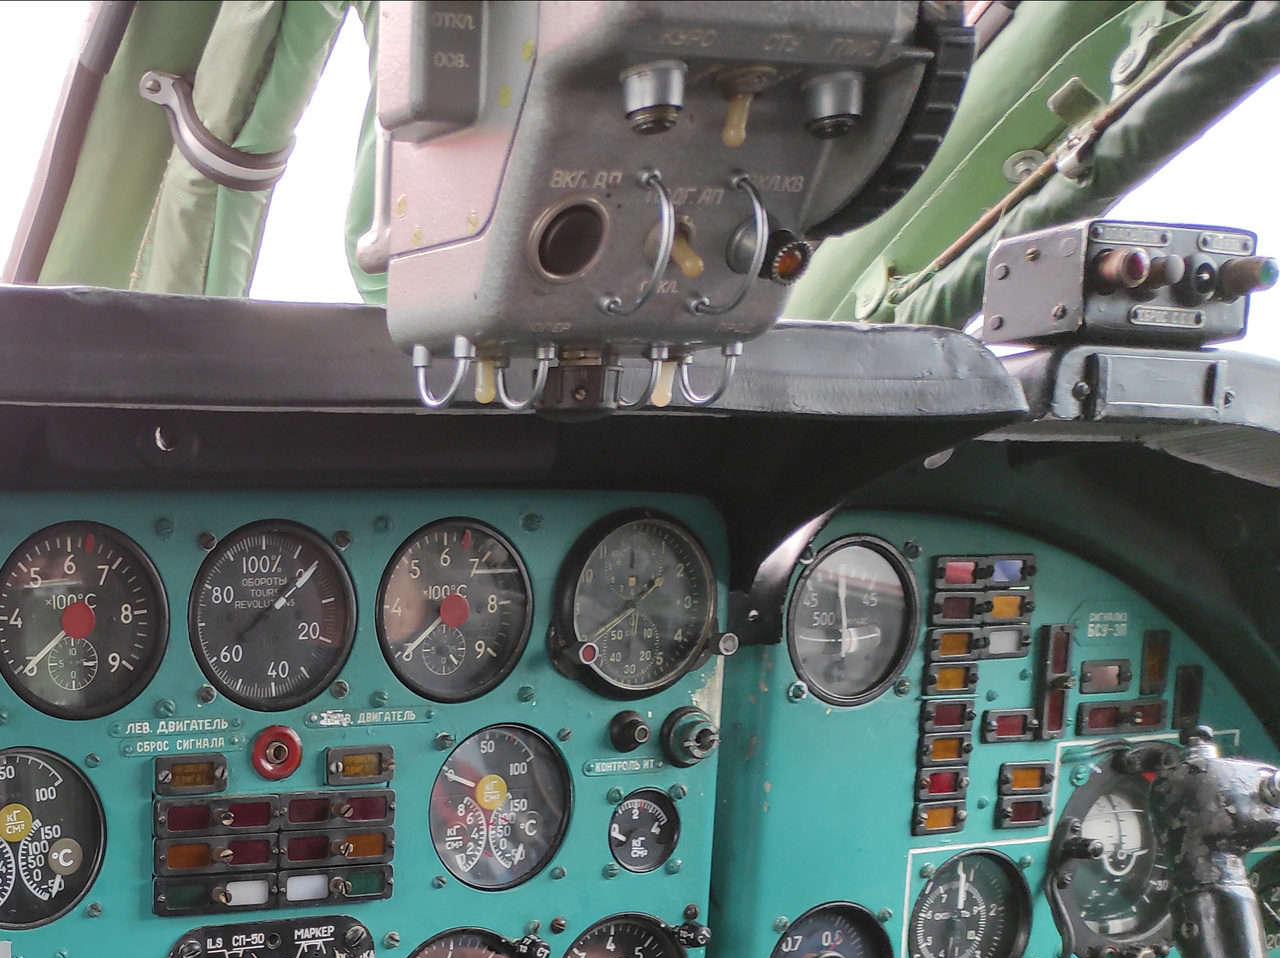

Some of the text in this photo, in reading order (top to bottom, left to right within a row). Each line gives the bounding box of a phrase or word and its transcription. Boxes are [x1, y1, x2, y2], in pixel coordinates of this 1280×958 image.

[211, 585, 234, 604] 80
[120, 603, 133, 624] 8
[297, 622, 320, 641] 20
[220, 644, 243, 664] 60
[267, 660, 289, 679] 40
[357, 710, 416, 724] ДВИГАТЕЛЬ
[125, 718, 229, 735] ЛЕВ. ДВИГАТЕЛЬ
[136, 736, 225, 754] СБРОС СИГНАЛА
[480, 741, 495, 754] 50
[509, 763, 528, 776] 100
[35, 786, 57, 802] 100
[40, 824, 61, 839] 150
[232, 933, 265, 946] СП-50
[294, 925, 335, 940] МАРКЕР
